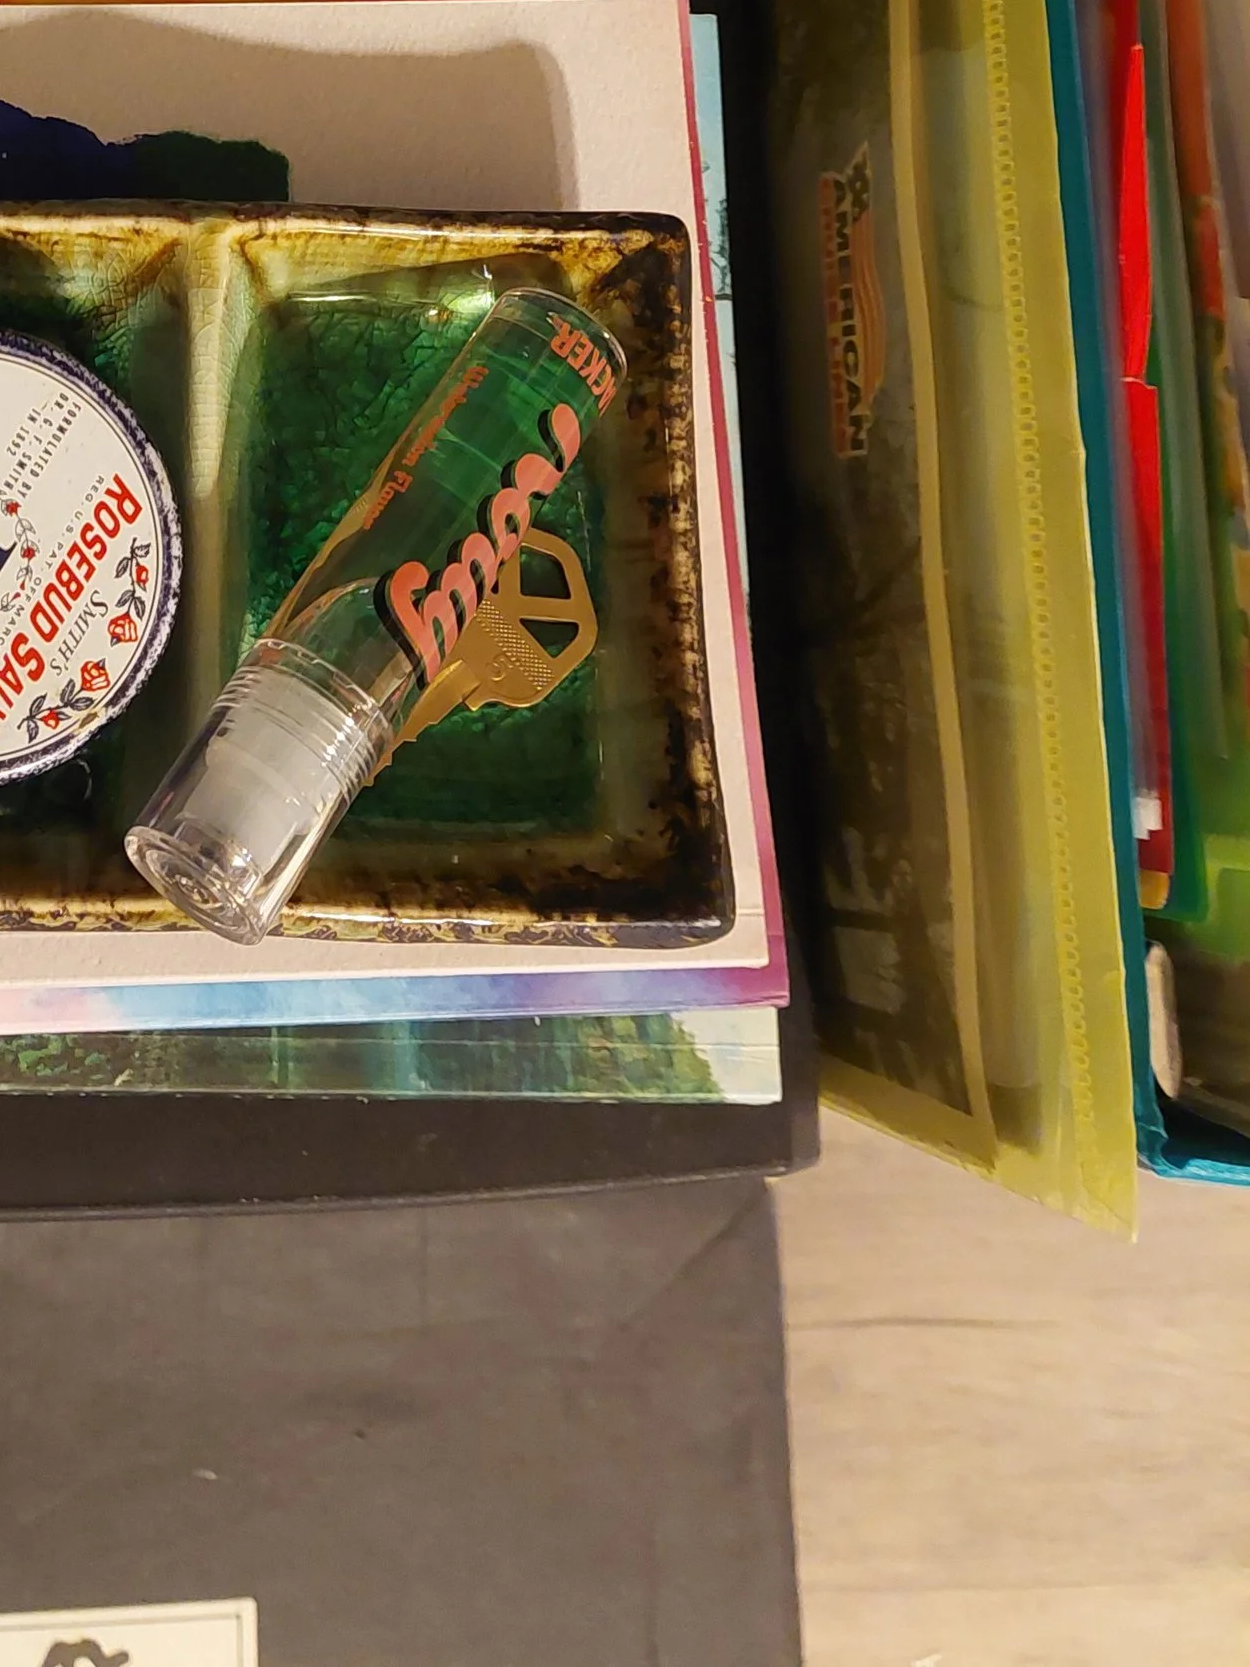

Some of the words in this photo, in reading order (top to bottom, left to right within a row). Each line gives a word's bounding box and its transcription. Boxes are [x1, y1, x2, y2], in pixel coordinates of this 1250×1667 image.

[27, 407, 41, 424] IN
[6, 426, 30, 457] 1892
[30, 402, 82, 478] FORMULATED
[3, 451, 32, 490] SMITH
[17, 482, 32, 499] BY
[29, 473, 143, 644] ROSEBUD
[50, 589, 110, 677] SMITH'S
